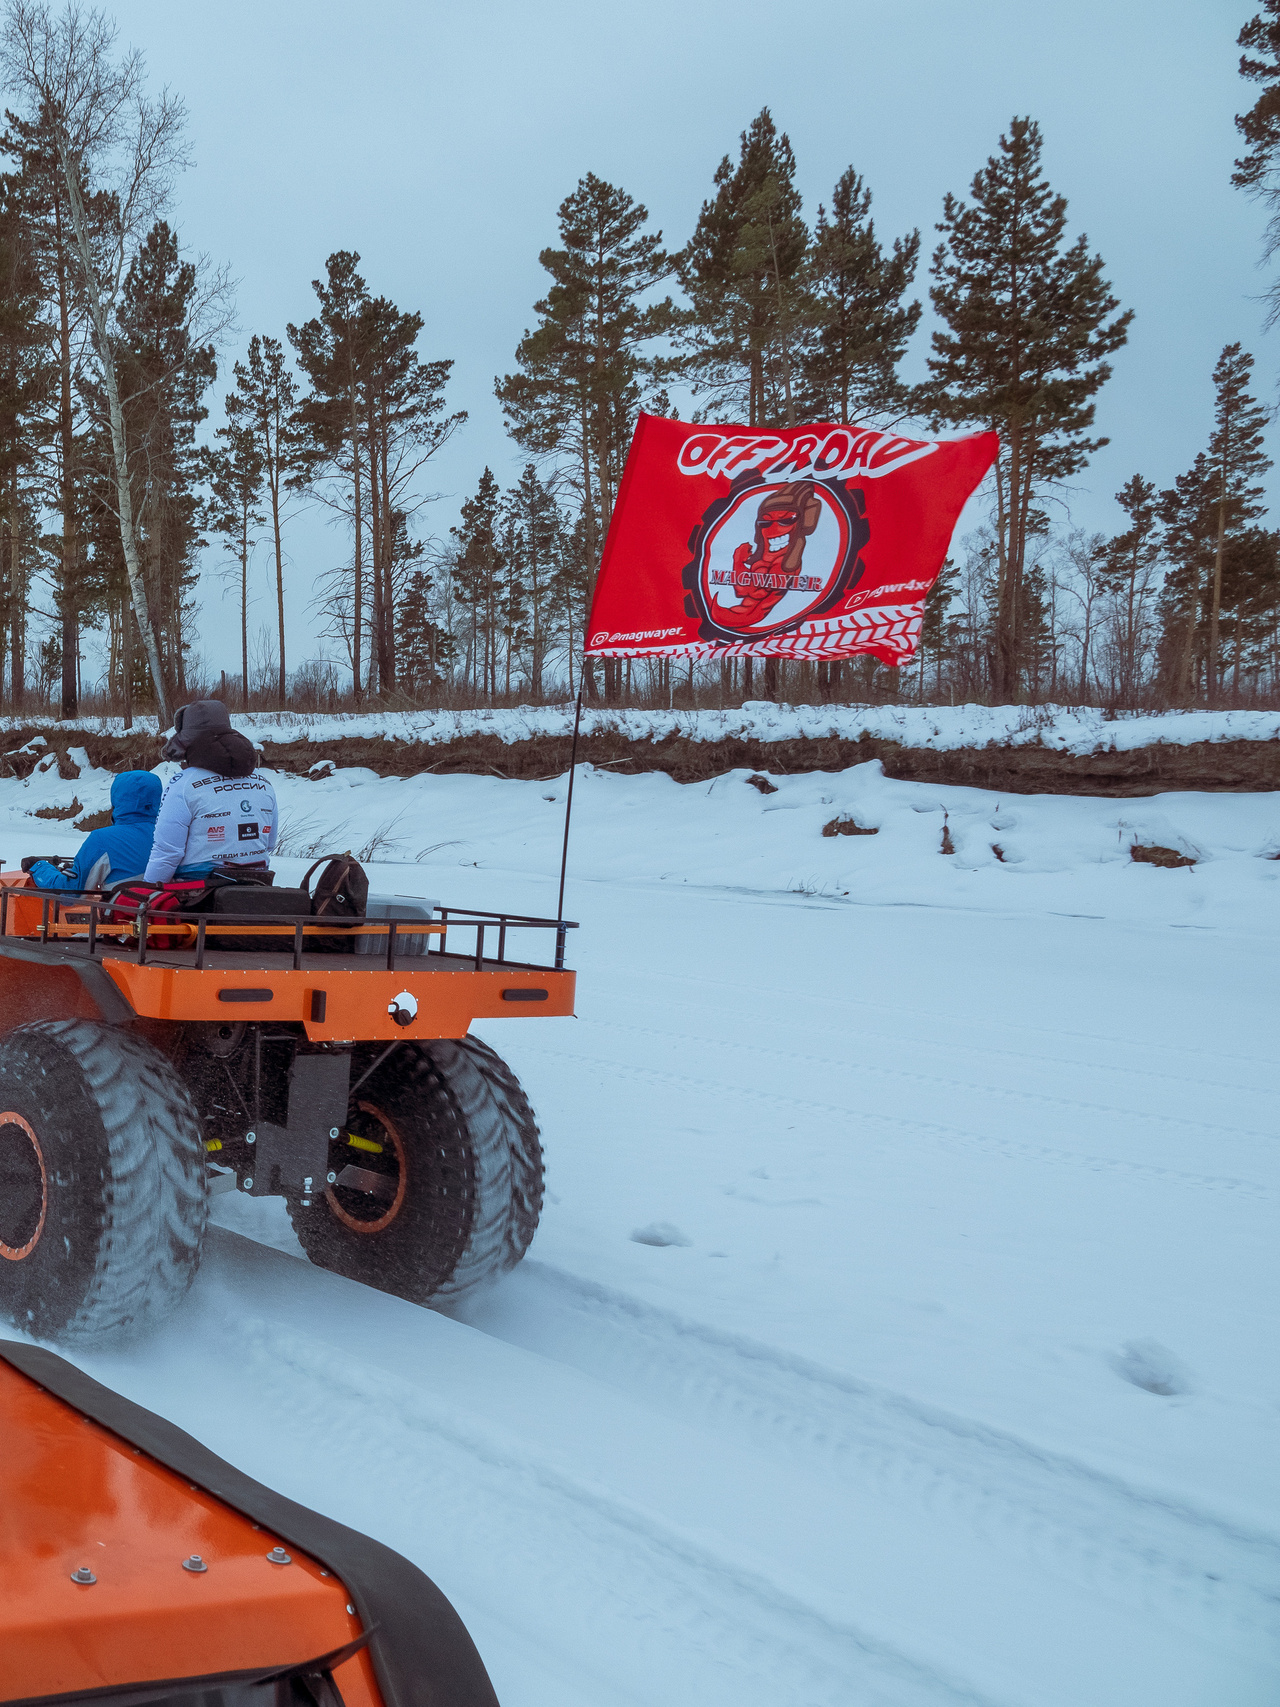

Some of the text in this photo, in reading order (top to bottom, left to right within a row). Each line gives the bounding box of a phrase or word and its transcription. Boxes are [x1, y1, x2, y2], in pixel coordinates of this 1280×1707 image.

[677, 429, 939, 483] OFF ROAD
[709, 569, 823, 592] MAGWAYER
[608, 626, 686, 642] @magwayer_
[213, 783, 266, 794] РОССИИ
